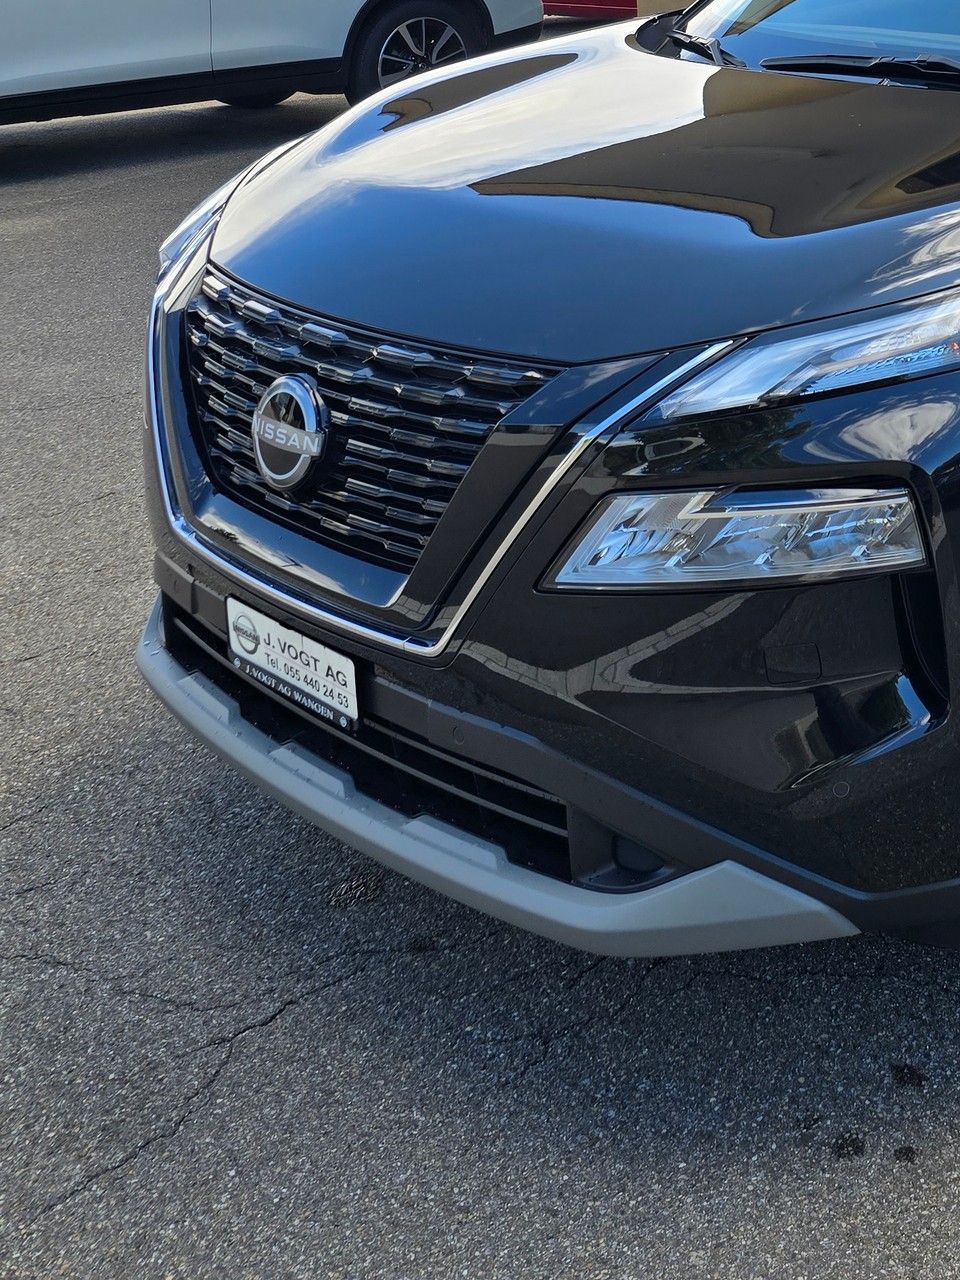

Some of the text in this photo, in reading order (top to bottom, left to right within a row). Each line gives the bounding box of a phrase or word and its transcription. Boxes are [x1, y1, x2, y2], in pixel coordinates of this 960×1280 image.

[253, 413, 319, 453] NISSAN
[263, 632, 348, 688] J. VOGT AG
[264, 652, 350, 709] Tel. 055 440 24 53
[278, 683, 292, 697] AG
[293, 690, 334, 720] WANGEN
